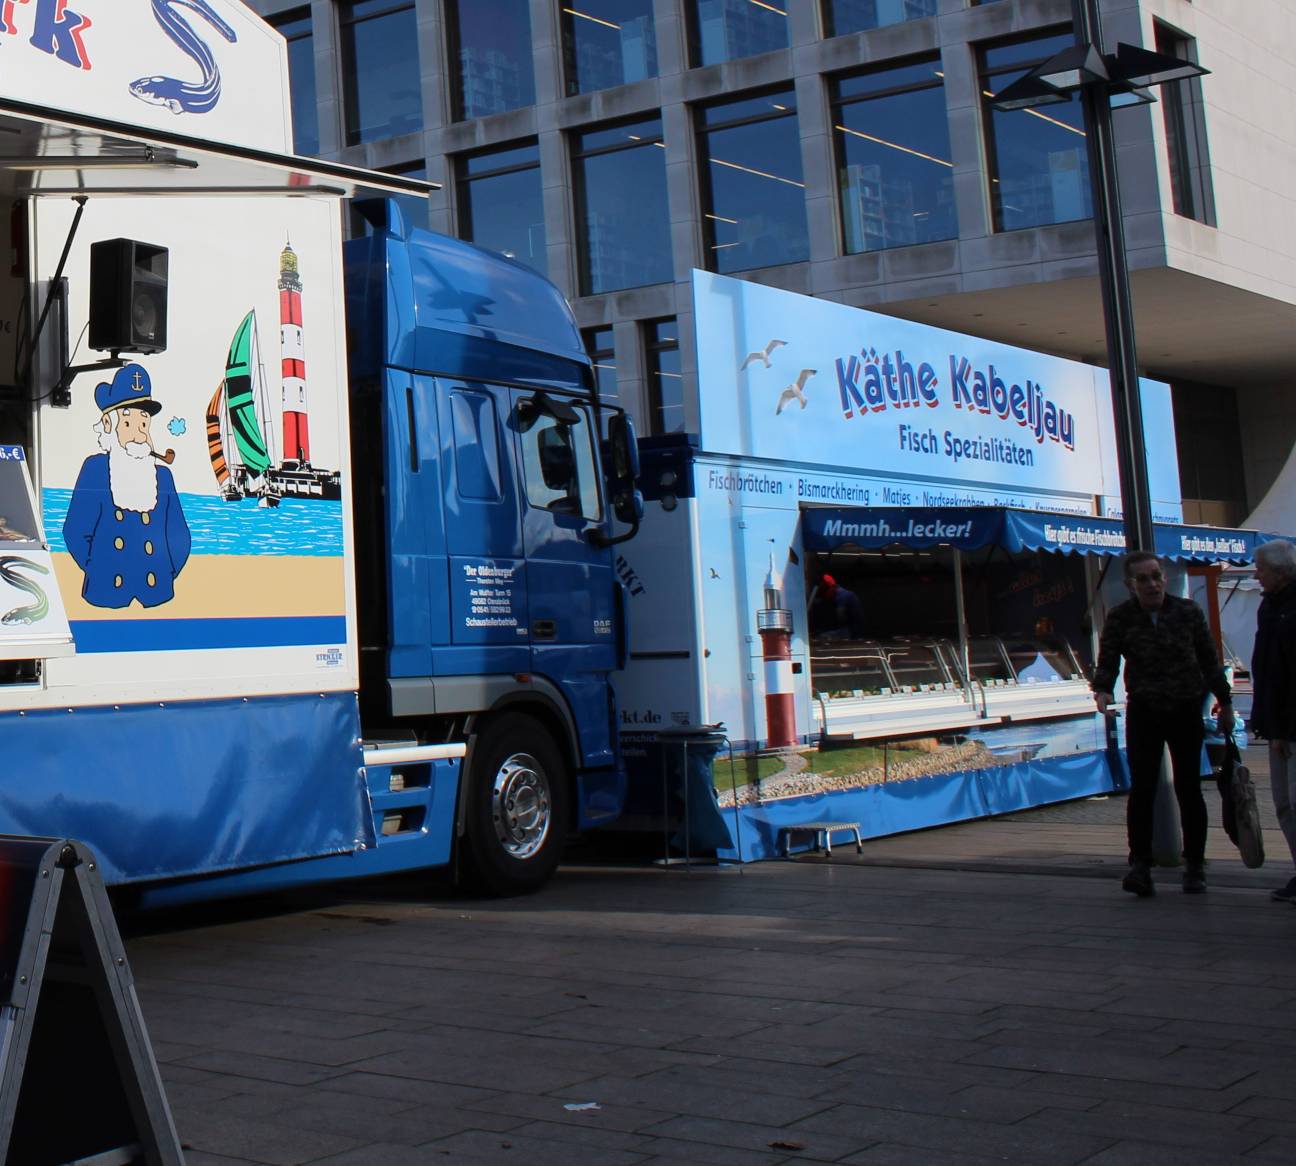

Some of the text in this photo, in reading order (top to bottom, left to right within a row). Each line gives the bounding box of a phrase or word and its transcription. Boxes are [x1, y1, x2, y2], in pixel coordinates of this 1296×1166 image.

[835, 347, 1075, 452] Käthe Kabeljau
[899, 424, 1034, 467] Fisch Spezialitäten
[708, 470, 783, 495] Fischbrötchen
[798, 478, 870, 505] Bismarckhering
[882, 487, 911, 507] Matjes
[465, 617, 518, 627] Schaustellerbetrieb
